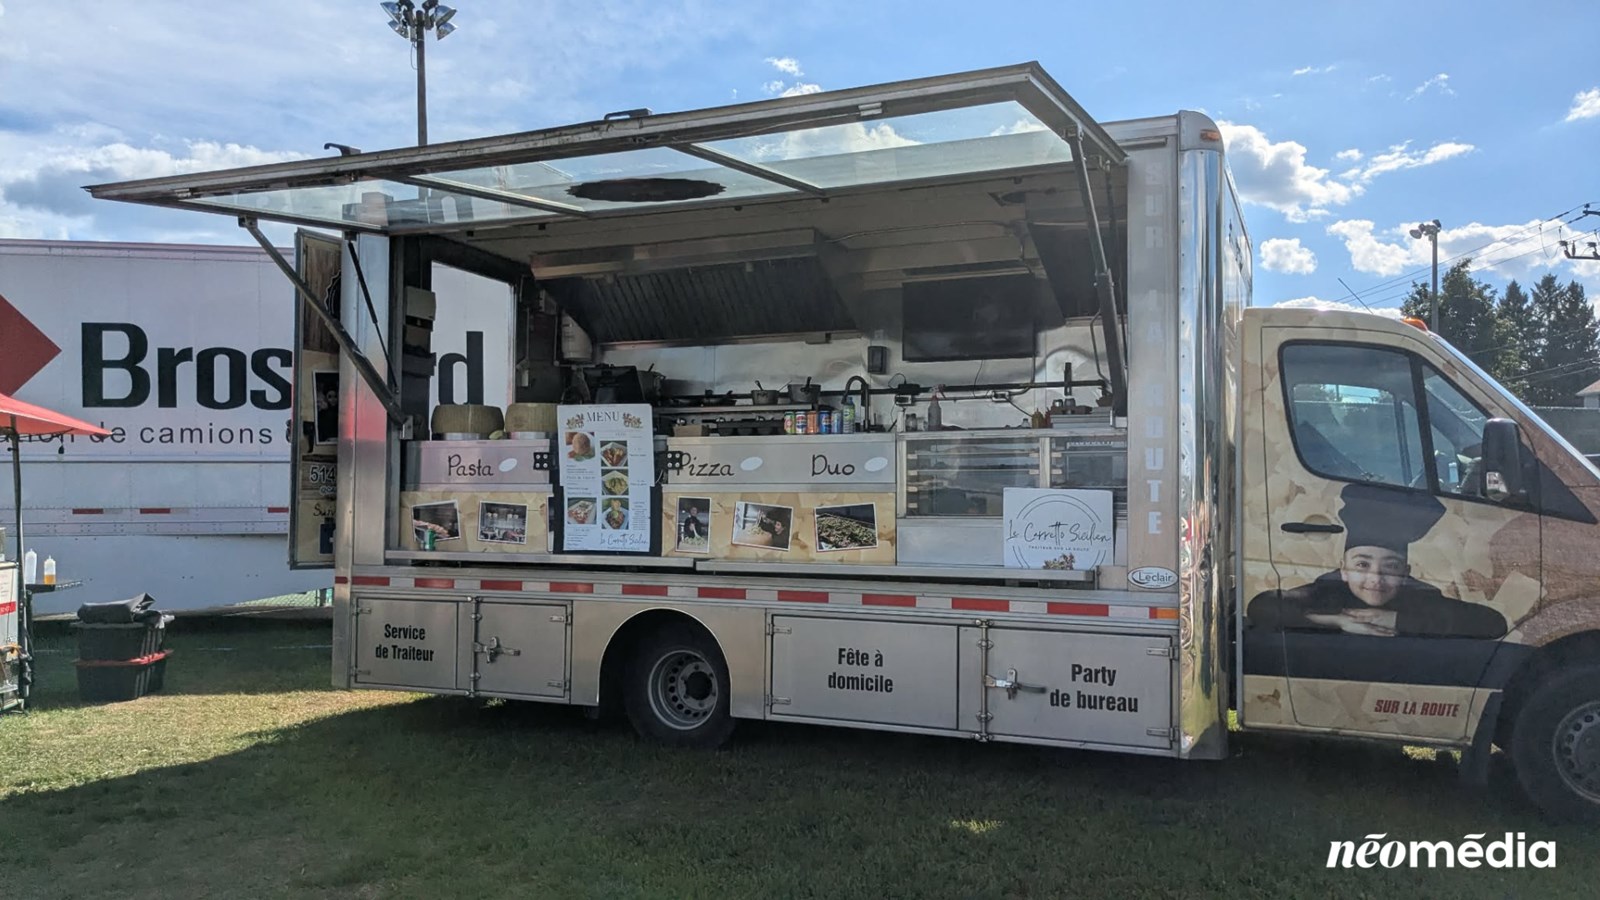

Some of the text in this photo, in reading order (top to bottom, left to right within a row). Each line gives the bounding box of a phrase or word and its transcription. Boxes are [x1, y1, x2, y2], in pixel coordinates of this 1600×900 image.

[586, 411, 619, 422] MENU
[140, 422, 273, 444] camions
[448, 454, 494, 476] Pasta
[676, 452, 734, 476] Pizza
[812, 454, 855, 476] Duo
[1144, 383, 1165, 535] ROUTE
[1138, 571, 1173, 582] Leclair
[384, 623, 426, 640] Service
[375, 644, 434, 661] de Traiteur
[838, 647, 884, 667] Fête à
[827, 671, 894, 693] domicile
[1071, 663, 1117, 686] Party
[1050, 688, 1139, 713] de bureau
[1374, 699, 1460, 717] SUR LA ROUTE
